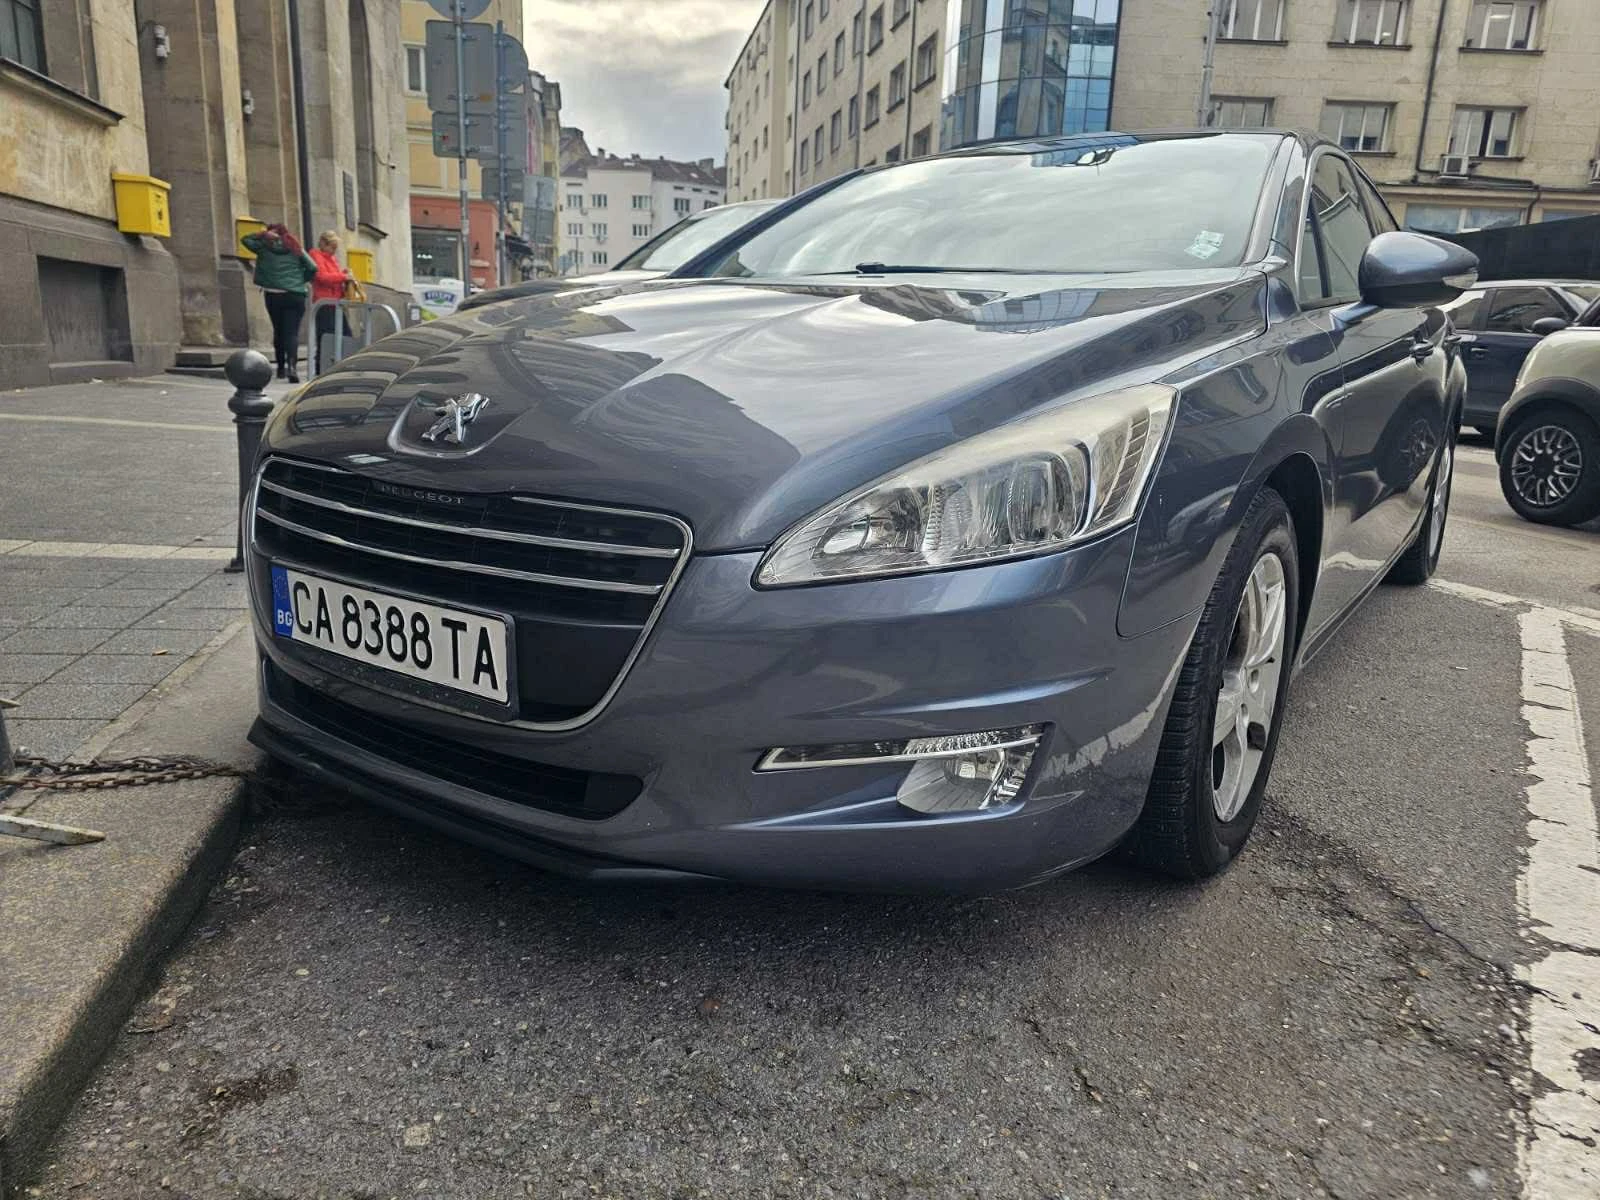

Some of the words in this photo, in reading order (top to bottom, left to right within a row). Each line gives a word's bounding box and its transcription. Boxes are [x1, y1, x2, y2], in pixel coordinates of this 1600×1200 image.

[277, 608, 293, 628] BG
[341, 594, 433, 669] 8388
[441, 617, 499, 690] TA
